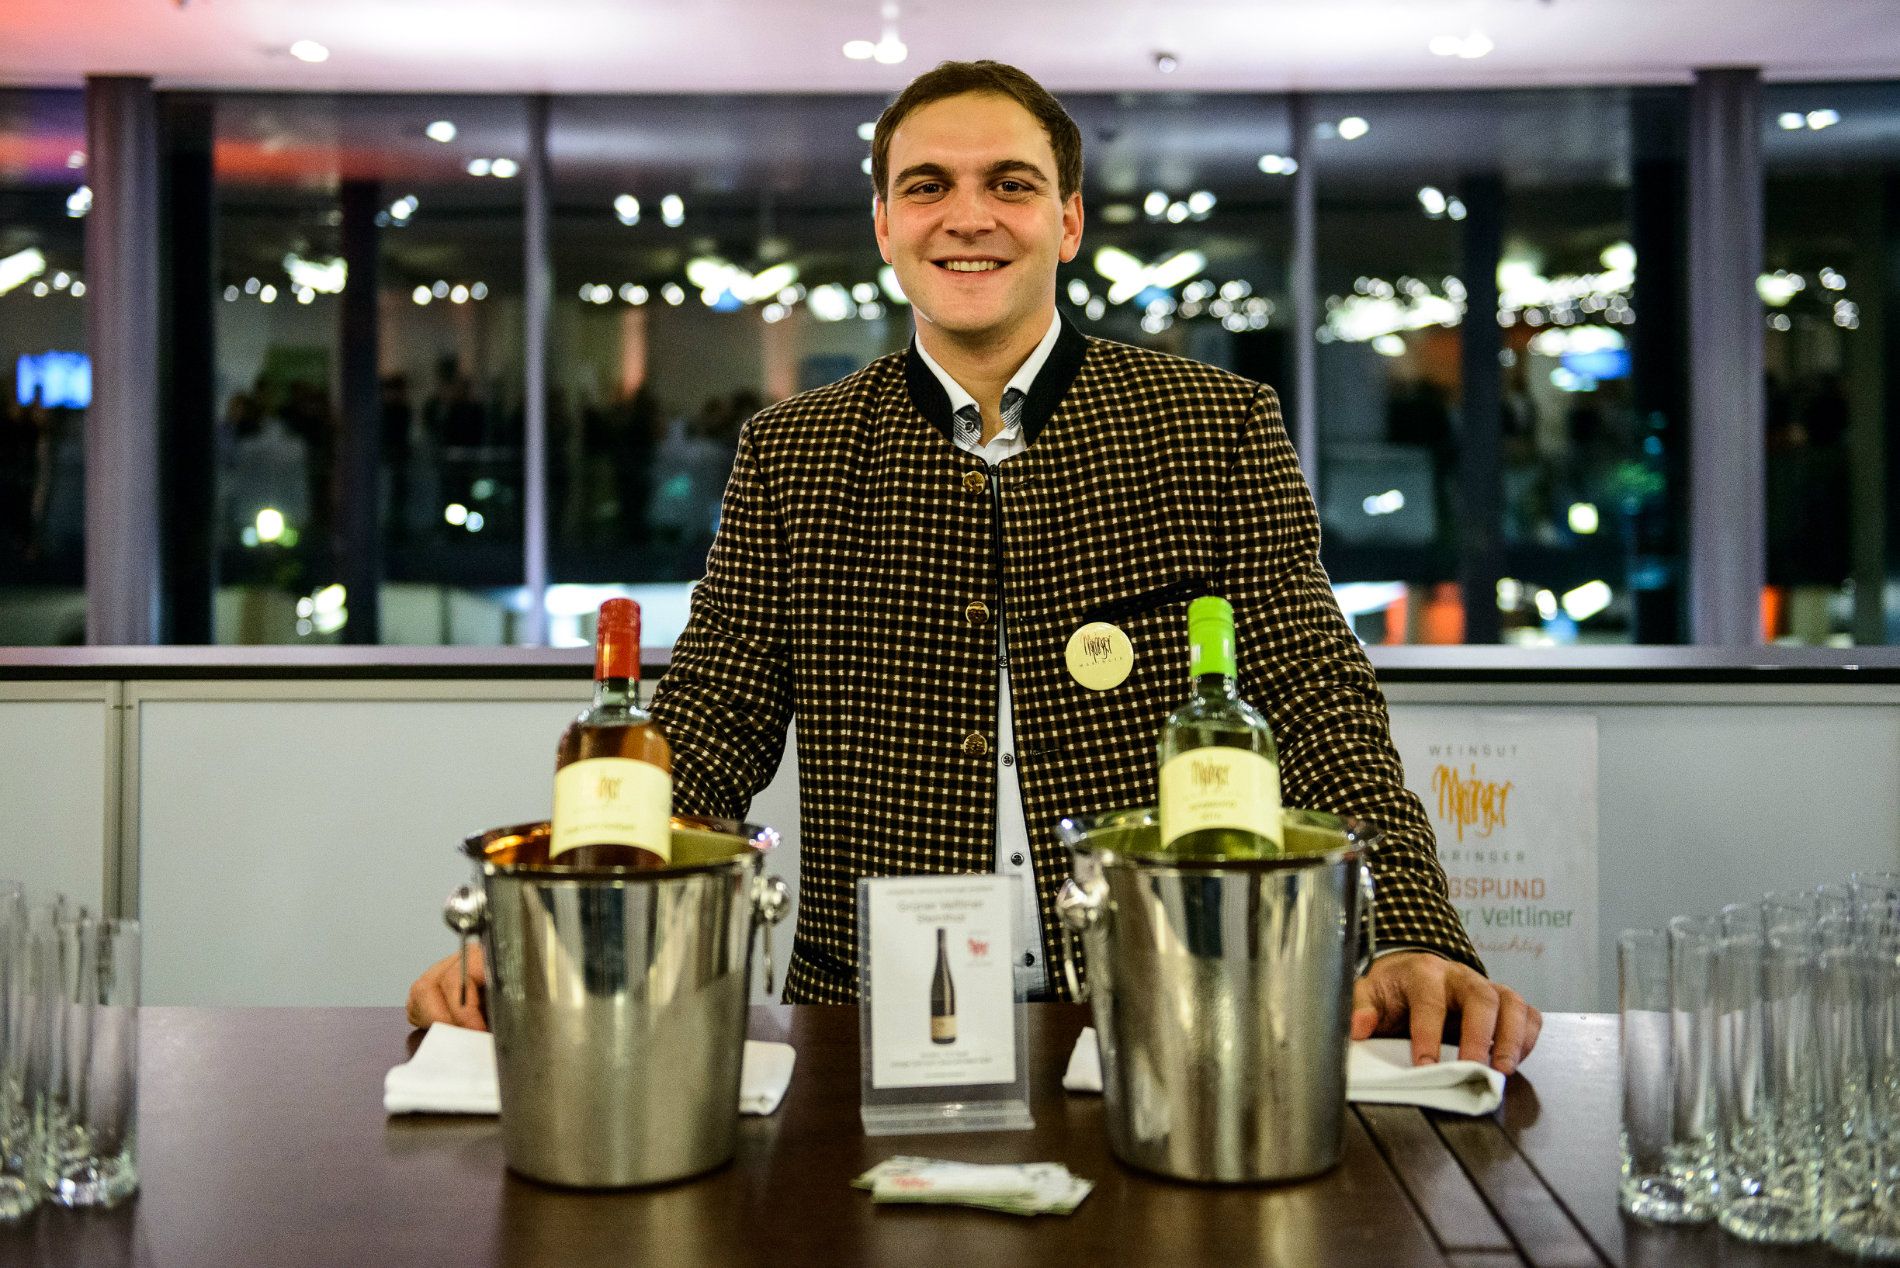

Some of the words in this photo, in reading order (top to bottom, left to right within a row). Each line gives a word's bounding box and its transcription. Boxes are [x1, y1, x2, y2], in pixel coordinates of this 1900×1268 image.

[1428, 744, 1518, 757] WEINGUT
[1438, 850, 1526, 863] ARINGER
[1448, 876, 1546, 900] GSPUND
[1481, 905, 1575, 928] Veltliner
